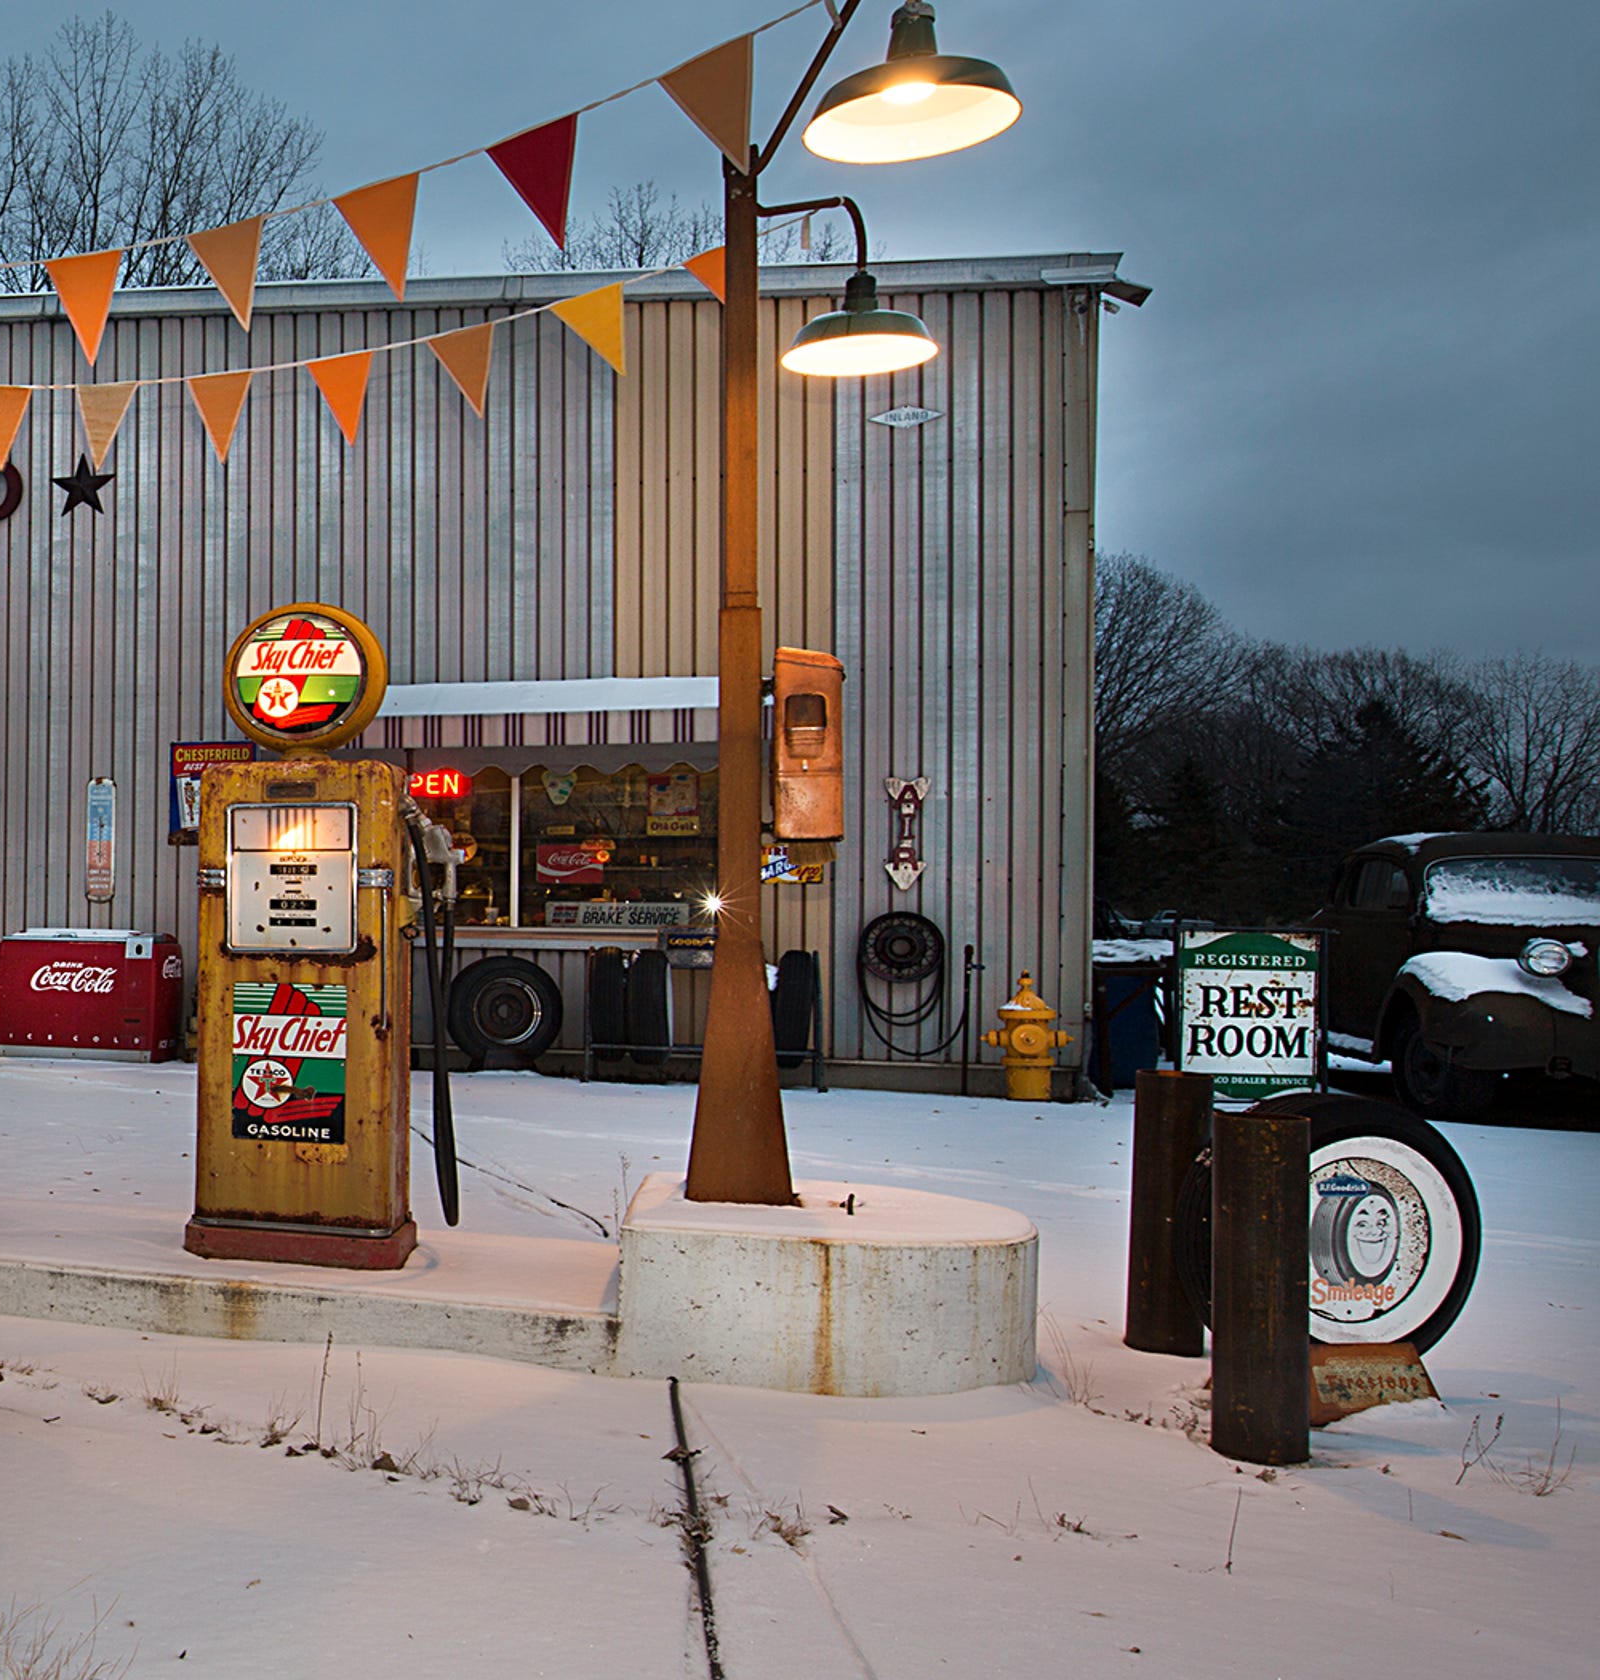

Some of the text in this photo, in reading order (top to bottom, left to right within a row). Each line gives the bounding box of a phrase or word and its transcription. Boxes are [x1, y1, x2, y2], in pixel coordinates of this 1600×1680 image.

[885, 411, 929, 422] INLAND
[251, 641, 345, 673] Sky Chief
[175, 748, 250, 762] CHESTERFIELD
[411, 773, 460, 795] PEN
[892, 784, 923, 871] AIR
[583, 911, 623, 924] BRAKE
[628, 911, 679, 925] SERVICE
[1194, 953, 1306, 968] REGISTERED
[30, 965, 117, 993] Coca-Cola
[1199, 985, 1303, 1019] REST
[232, 1015, 347, 1056] Sky Chief
[1187, 1024, 1309, 1058] ROOM
[247, 1123, 331, 1139] GASOLINE
[1311, 1277, 1395, 1307] Smileage
[1324, 1374, 1420, 1391] Firestone
